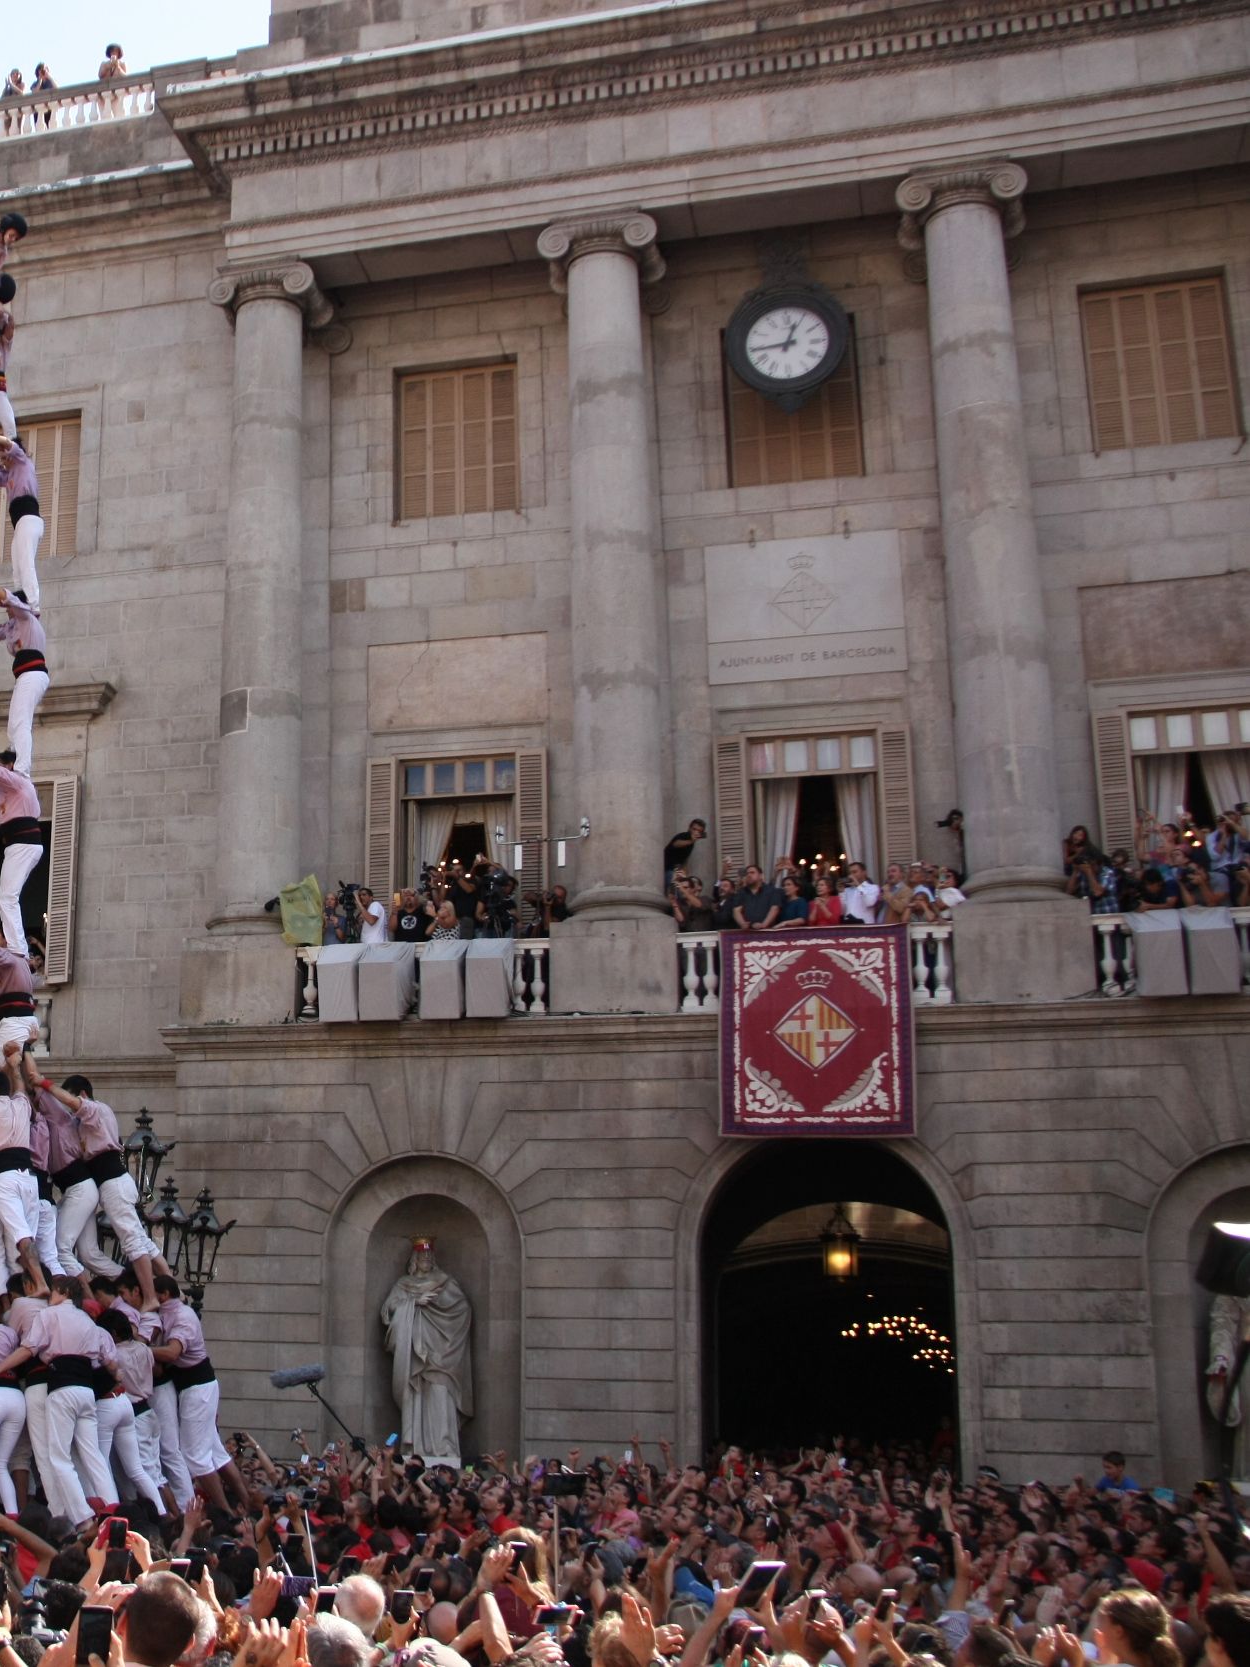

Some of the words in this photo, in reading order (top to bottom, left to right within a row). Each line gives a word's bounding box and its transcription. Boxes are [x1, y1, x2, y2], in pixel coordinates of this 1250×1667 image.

[718, 653, 795, 668] AJUNTAMENT
[801, 651, 817, 662] DE
[823, 646, 896, 660] BARCELONA
